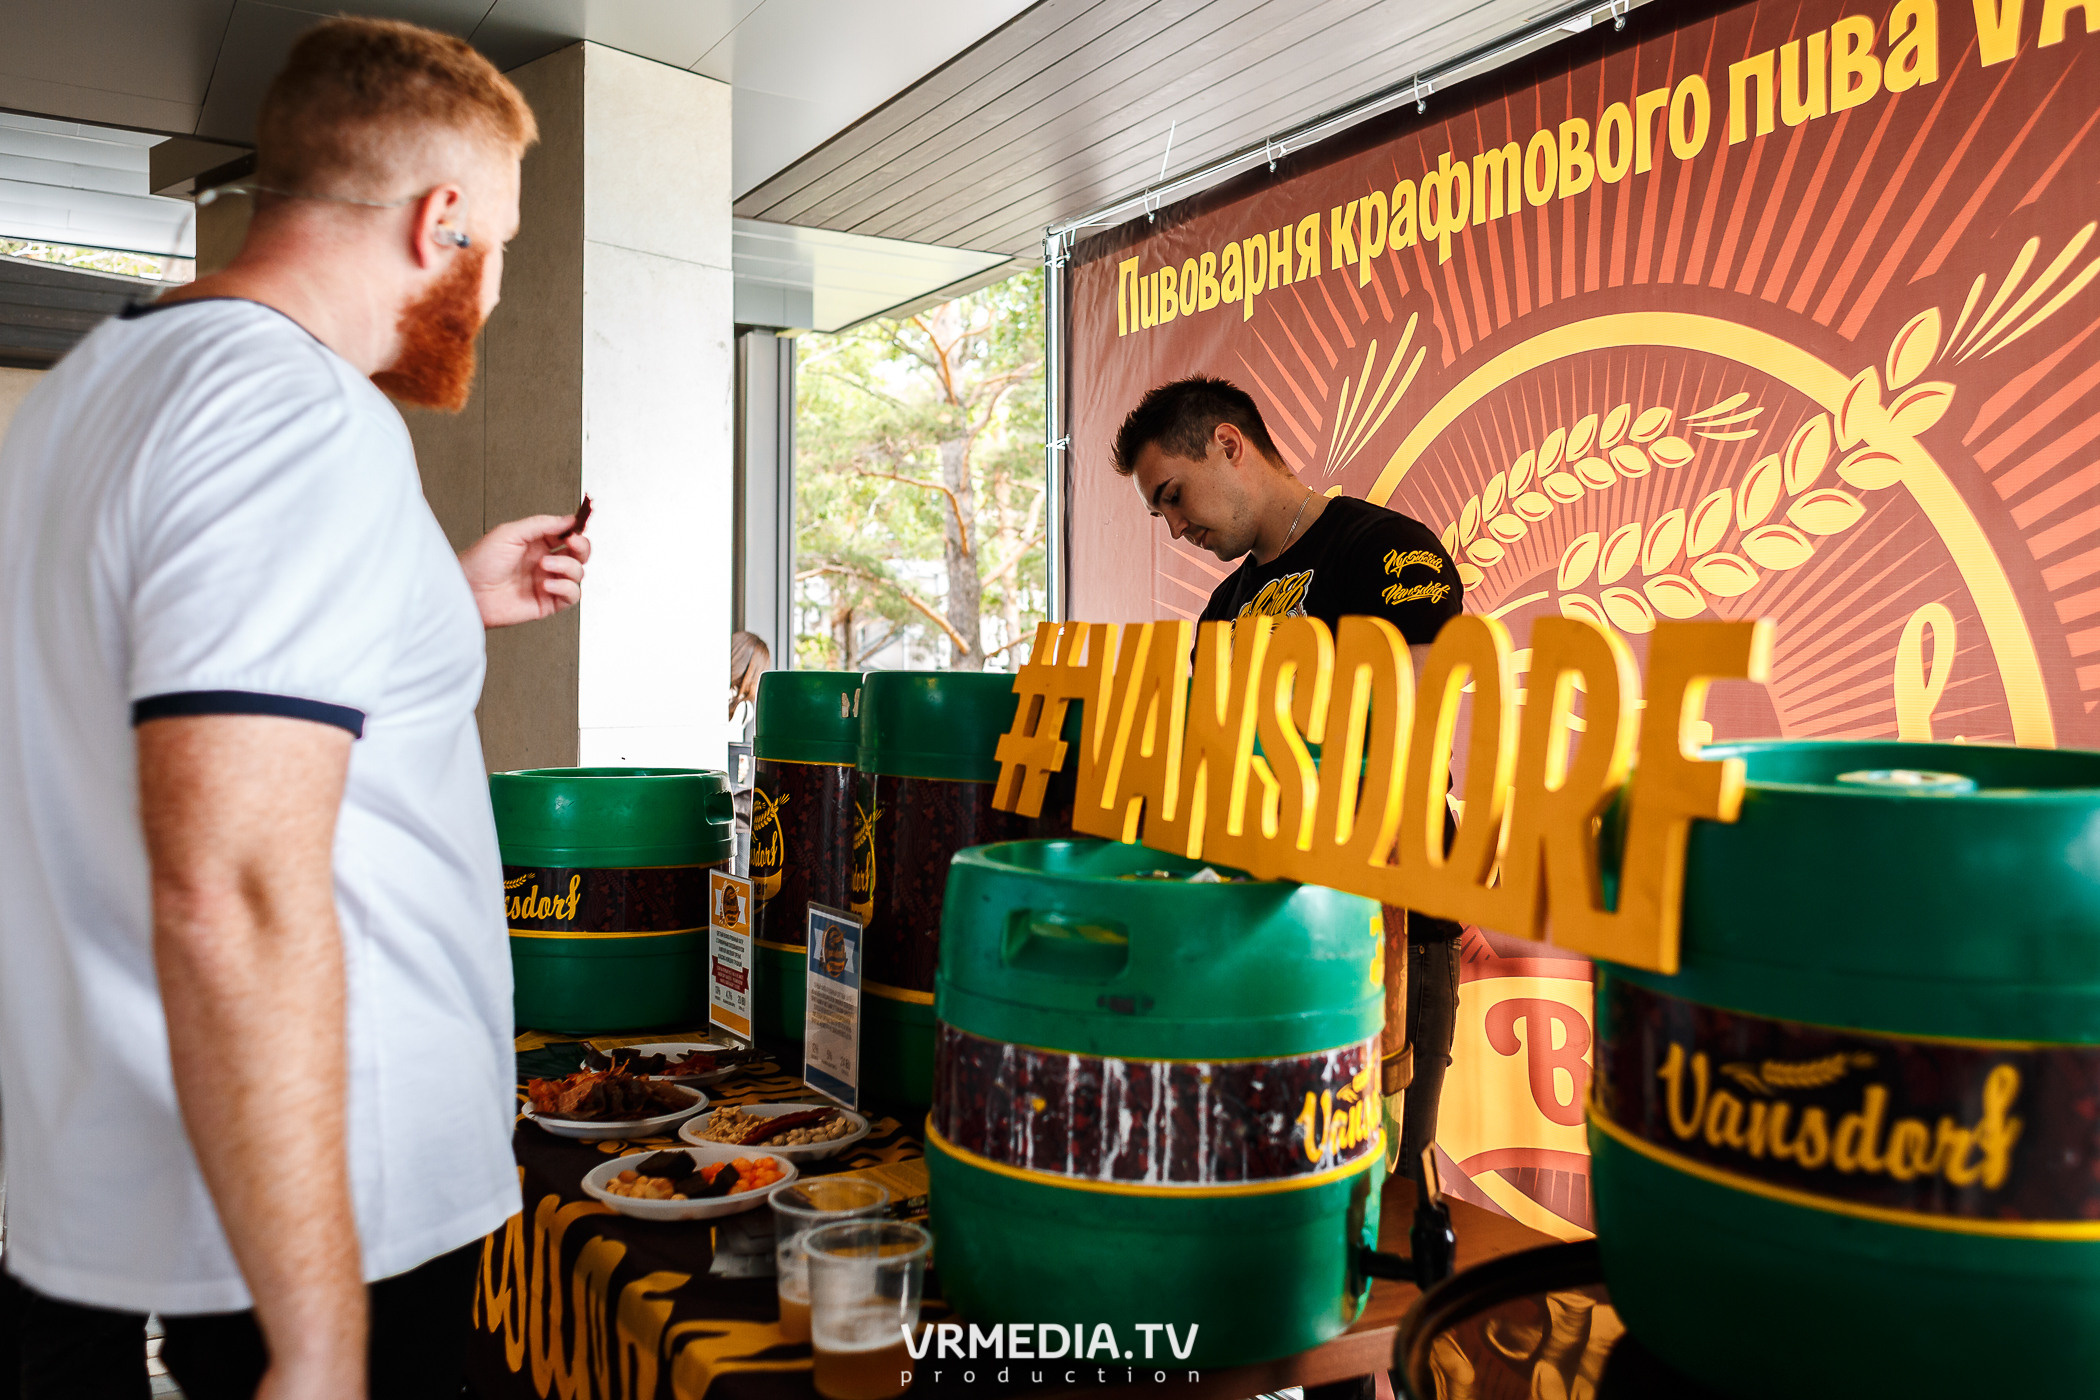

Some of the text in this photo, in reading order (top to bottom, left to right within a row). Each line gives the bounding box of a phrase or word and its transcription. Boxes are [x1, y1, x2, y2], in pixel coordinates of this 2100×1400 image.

[1118, 211, 1321, 337] Пивоварня
[1331, 73, 1711, 289] крафтового
[1728, 0, 1939, 145] пива
[991, 614, 1775, 976] #VANSDORF
[1656, 1041, 2023, 1189] Vansdorf
